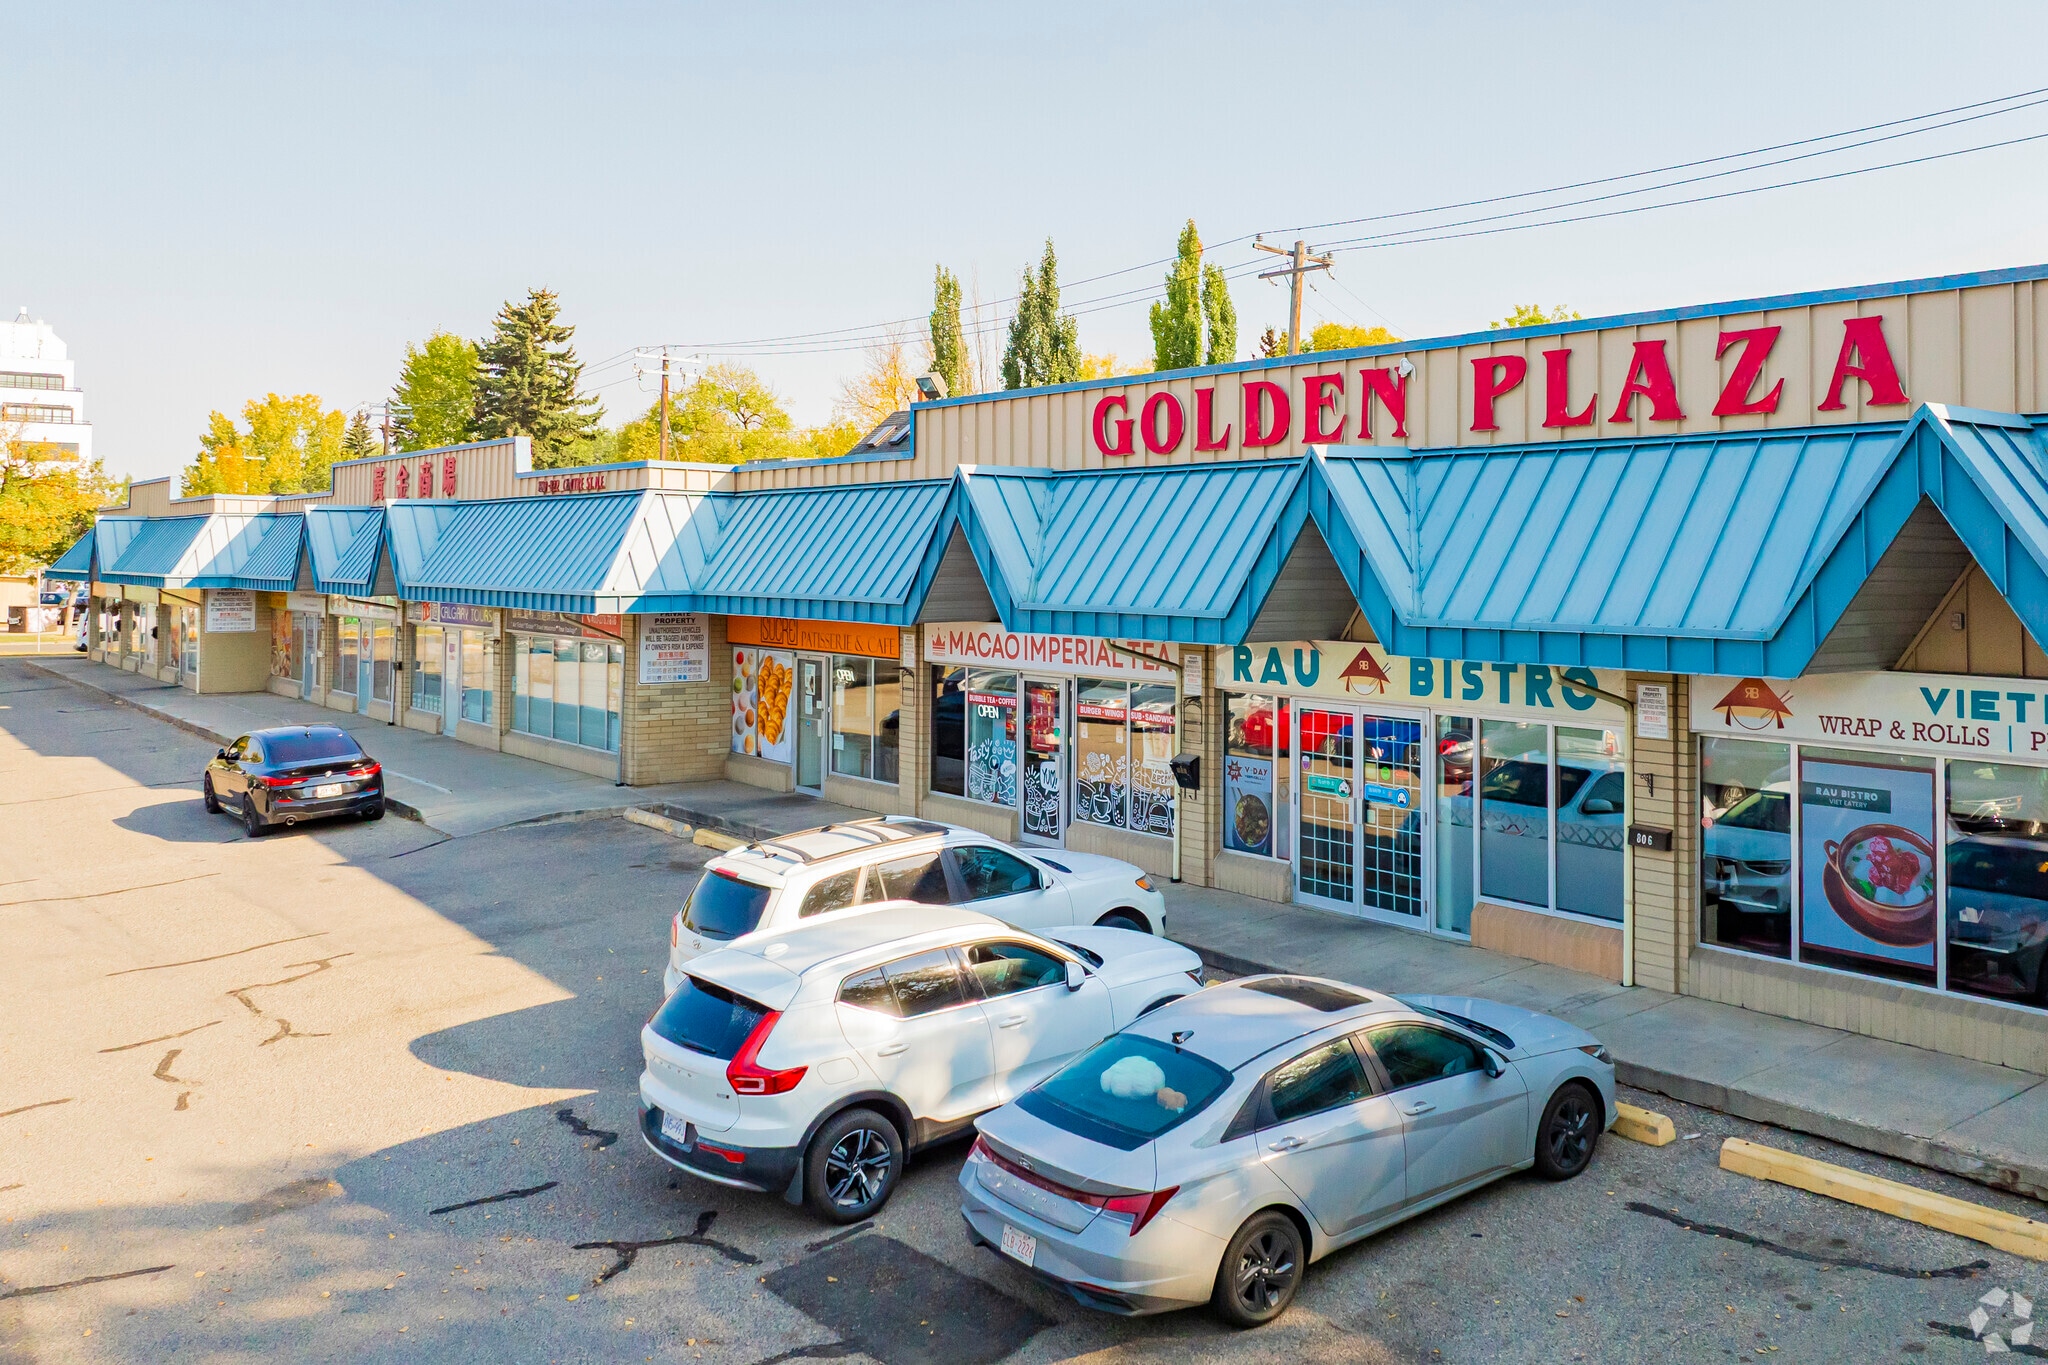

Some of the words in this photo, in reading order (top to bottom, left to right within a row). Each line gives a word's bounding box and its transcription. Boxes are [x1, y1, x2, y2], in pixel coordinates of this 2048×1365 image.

[1093, 368, 1408, 456] GOLDEN
[1470, 315, 1911, 432] PLAZA
[440, 605, 468, 621] CALGARY
[648, 626, 681, 634] UNAUTHORIZED
[682, 626, 701, 634] VEHICLES
[645, 635, 655, 643] WILL
[801, 631, 850, 651] PATISSERIE
[854, 635, 863, 652] &
[949, 630, 1019, 660] MACAO
[1024, 635, 1124, 668] IMPERIAL
[1126, 640, 1176, 673] TEA
[836, 668, 855, 682] OPEN
[1233, 646, 1320, 688] RAU
[1410, 657, 1599, 711] BISTRO
[969, 694, 985, 703] BUBBLE
[986, 695, 995, 705] TEA
[998, 697, 1017, 706] COFFEE
[1919, 686, 2048, 725] VIET
[978, 704, 999, 719] OPEN
[1080, 706, 1102, 716] BURGER
[1105, 708, 1124, 719] WINGS
[1131, 711, 1142, 721] SUB
[1819, 715, 1882, 738] WRAP
[1890, 720, 1906, 740] &
[1912, 722, 1990, 747] ROLLS
[2030, 731, 2048, 752] P
[1815, 786, 1838, 797] RAU
[1841, 789, 1878, 802] BISTRO
[1829, 798, 1842, 806] VIET
[1843, 800, 1867, 809] EATERY
[1636, 832, 1653, 846] 806
